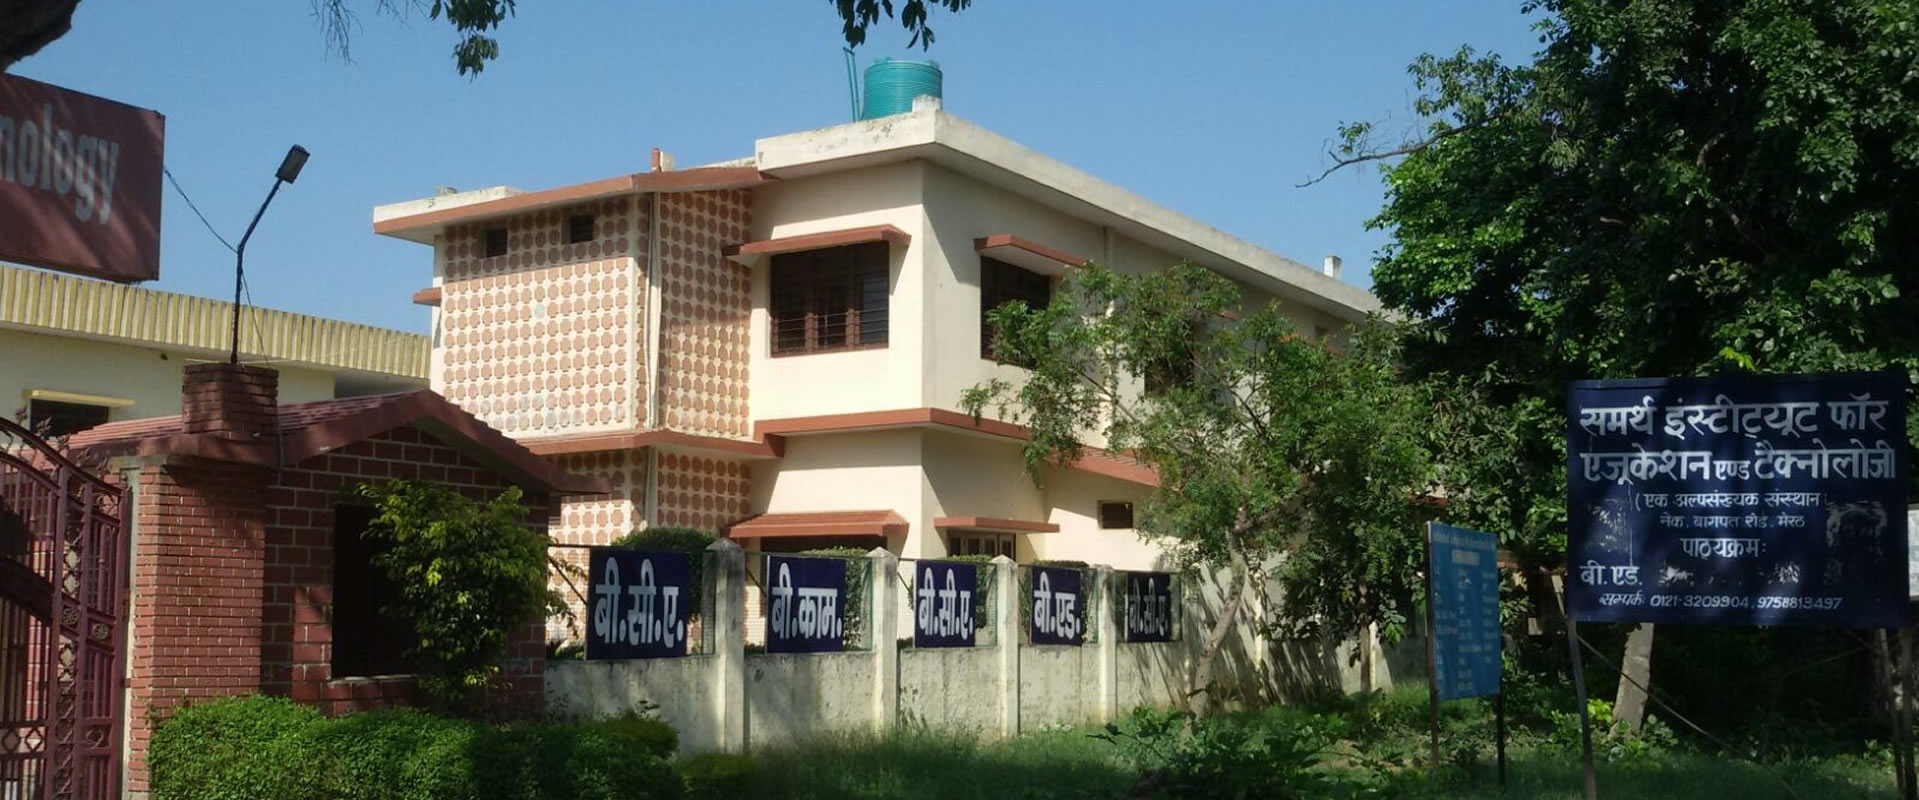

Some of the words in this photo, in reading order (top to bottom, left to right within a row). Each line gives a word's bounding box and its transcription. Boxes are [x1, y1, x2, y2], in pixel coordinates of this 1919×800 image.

[1579, 395, 1657, 436] समर्थ
[1827, 392, 1889, 431] फॉर
[1579, 442, 1713, 485] एजूकेशन
[1713, 460, 1751, 480] एण्ड
